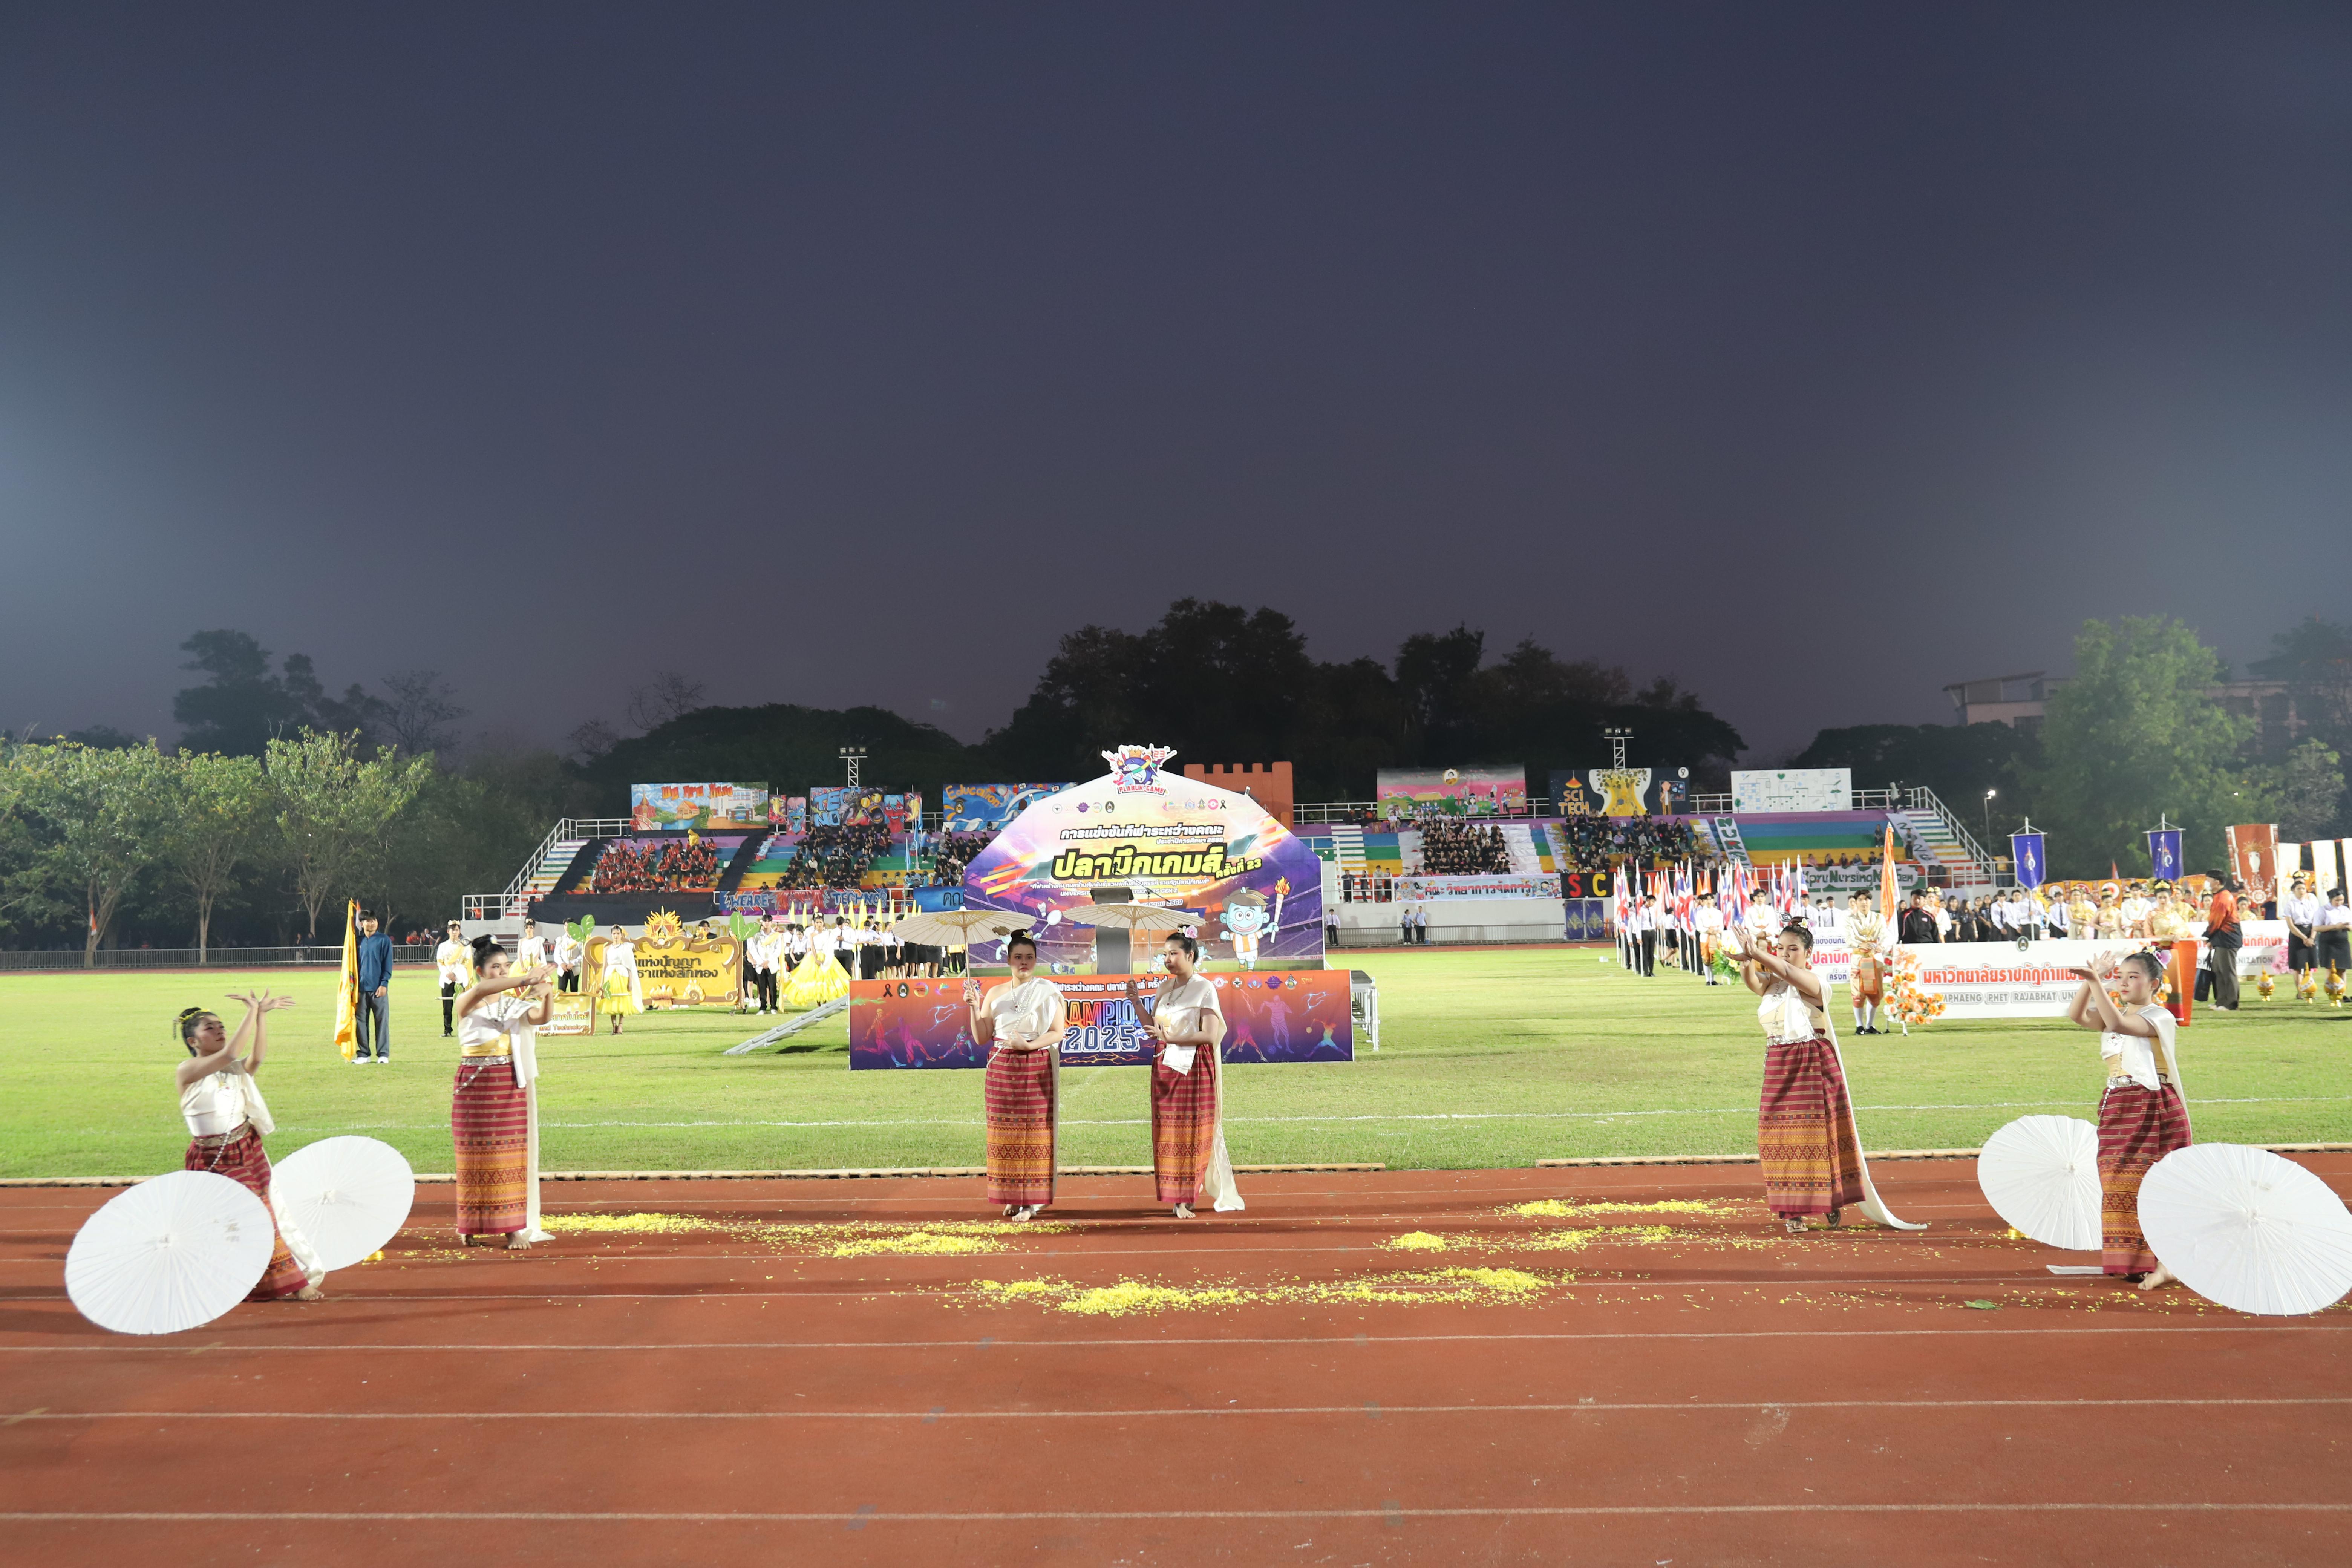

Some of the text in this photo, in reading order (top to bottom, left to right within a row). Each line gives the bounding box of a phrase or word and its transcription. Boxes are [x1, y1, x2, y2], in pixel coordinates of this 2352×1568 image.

[1563, 789, 1584, 802] SCI
[1558, 801, 1589, 815] TECH
[1060, 822, 1224, 840] การแข่งขันกีฬาระหว่างคณะ
[1053, 845, 1226, 879] ปลาบึกเกมส์
[1246, 858, 1262, 871] 23
[1425, 886, 1445, 896] คณะ
[943, 892, 963, 906] คณ
[1943, 994, 1982, 1003] MPHAENG
[1988, 993, 2008, 1002] PHET
[2014, 992, 2056, 1001] RAJABHAT
[1063, 1026, 1139, 1052] 2025
